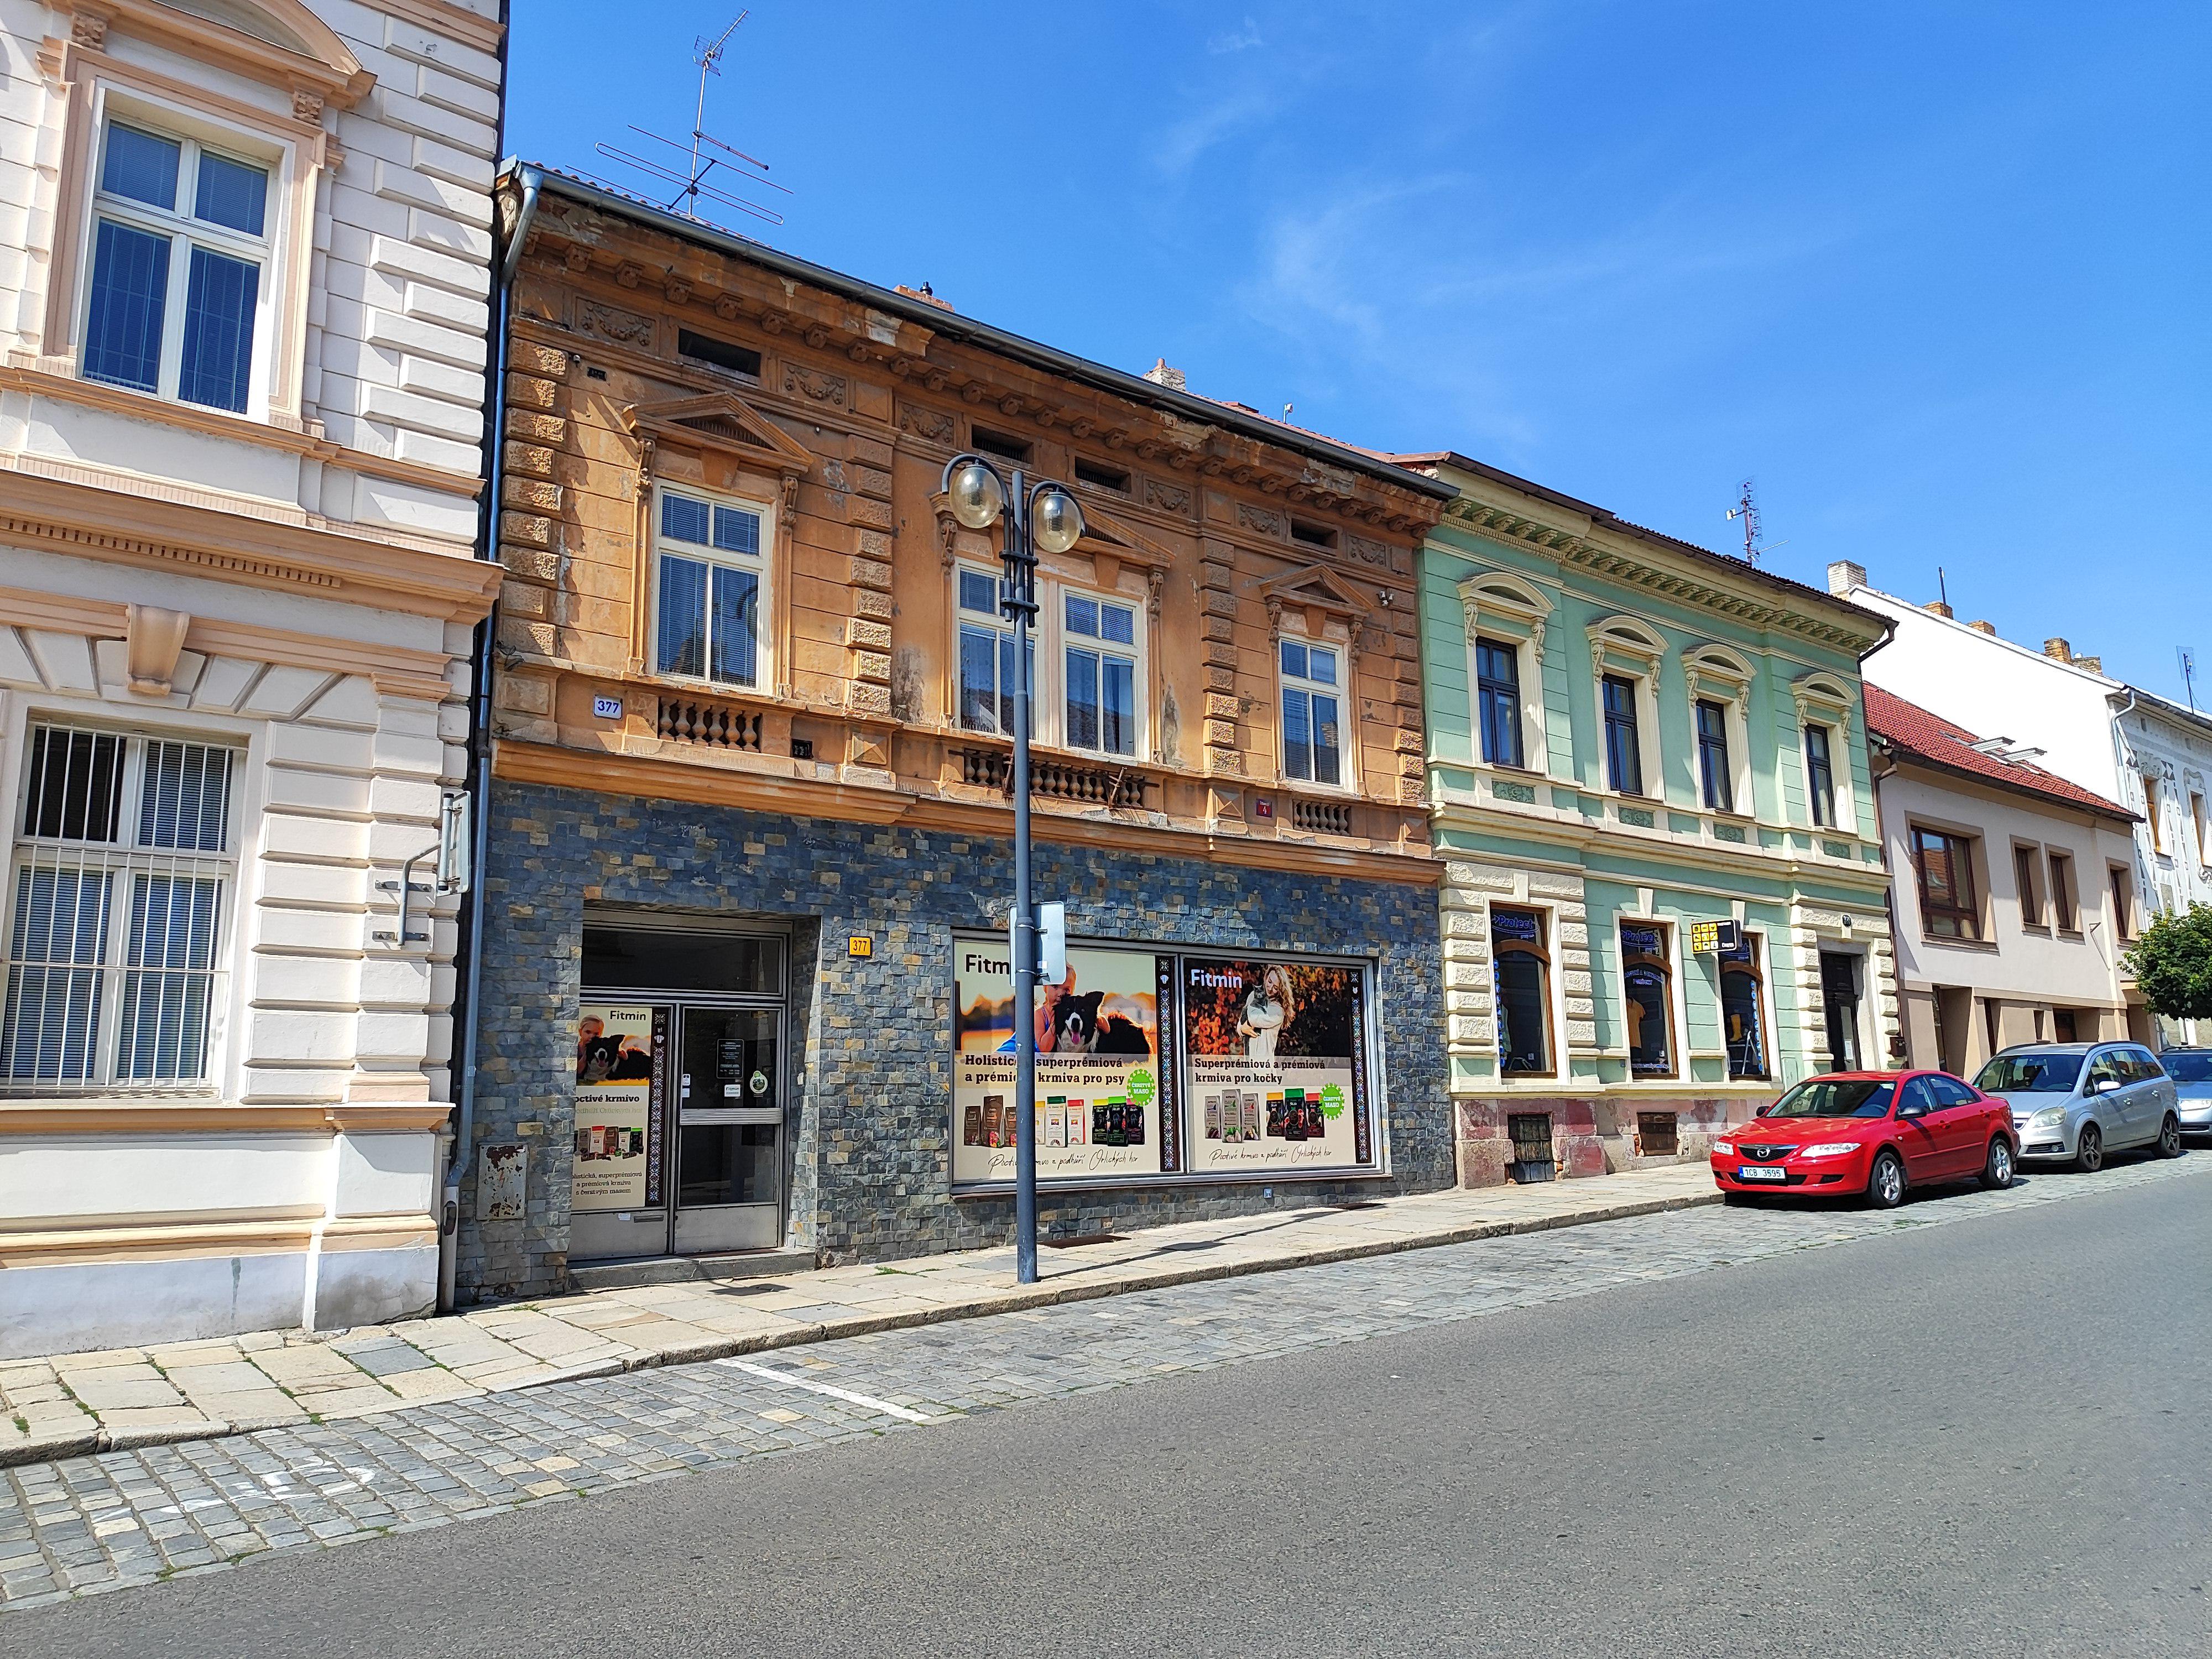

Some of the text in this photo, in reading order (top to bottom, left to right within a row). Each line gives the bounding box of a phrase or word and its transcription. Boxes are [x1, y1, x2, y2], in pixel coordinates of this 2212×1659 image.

[597, 700, 619, 713] 377
[1499, 915, 1533, 929] Protect
[853, 940, 867, 952] 377
[966, 954, 1010, 975] Fitm
[1191, 969, 1242, 989] Fitmin
[610, 1010, 646, 1021] Fitmin
[965, 1055, 1123, 1070] Holistic superprémiová
[1194, 1058, 1271, 1070] Superprémiová
[1281, 1060, 1326, 1071] prémiová
[965, 1071, 1125, 1086] a prémi krmiva pro psy
[1195, 1072, 1282, 1084] krmiva pro kočky
[575, 1094, 603, 1103] octivé
[1089, 1149, 1126, 1170] Orlických
[1129, 1151, 1139, 1163] hor
